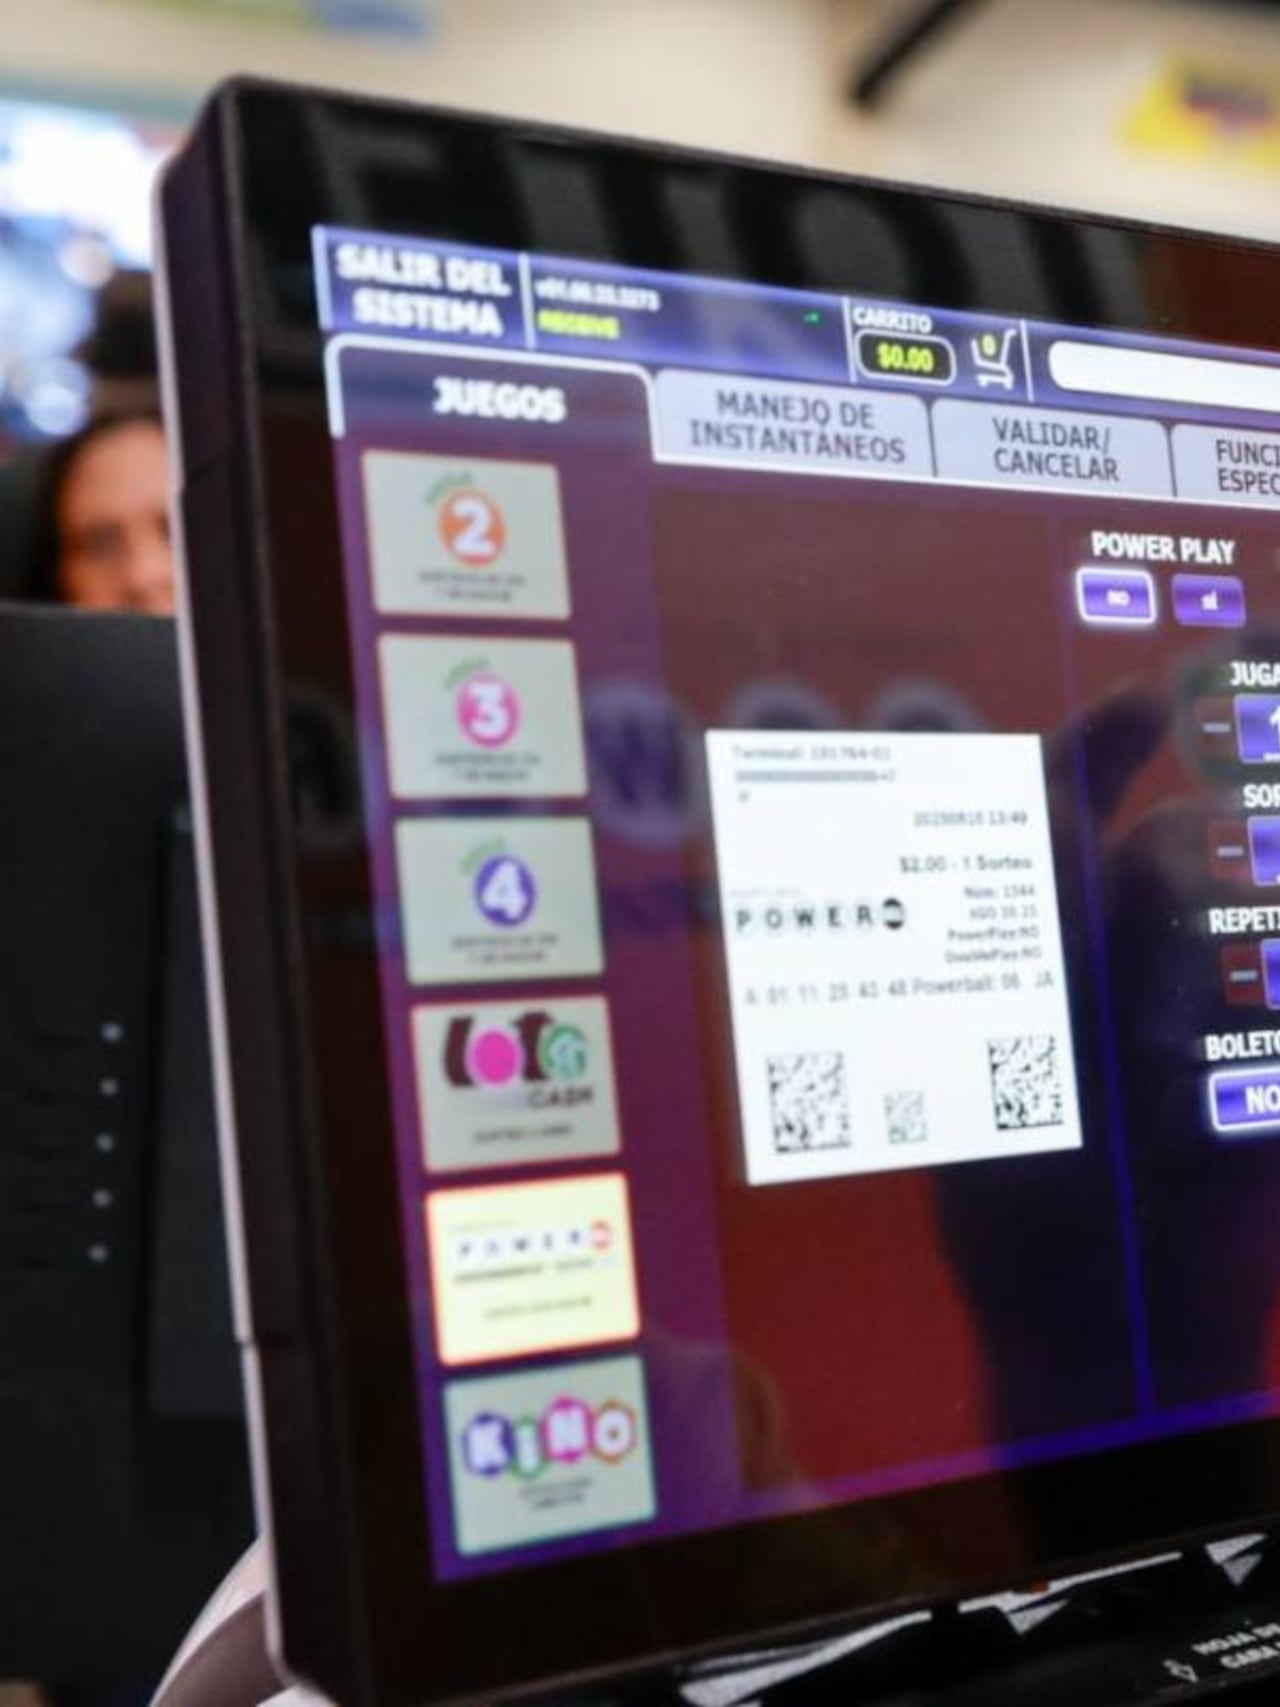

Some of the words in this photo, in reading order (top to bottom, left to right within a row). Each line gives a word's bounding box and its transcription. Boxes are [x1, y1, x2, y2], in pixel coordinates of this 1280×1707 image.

[336, 243, 440, 288] SALIR
[447, 256, 511, 296] DEL
[353, 288, 504, 337] SISTEMA
[853, 306, 932, 333] CARRITO
[876, 342, 934, 373] $0.00
[433, 377, 566, 423] JUEGOS
[717, 389, 830, 425] MANEJO
[840, 403, 875, 429] DE
[992, 417, 1111, 454] VALIDAR/
[994, 448, 1119, 482] CANCELAR
[452, 500, 496, 556] 2
[1091, 531, 1177, 562] POWER
[1180, 537, 1235, 565] PLAY
[467, 683, 510, 736] 3
[900, 856, 948, 874] $2.00
[977, 855, 1032, 871] Sorteo
[481, 856, 529, 923] 4
[528, 1086, 594, 1109] CASH
[1192, 1631, 1257, 1655] HOJA
[1220, 1646, 1280, 1669] CARA
